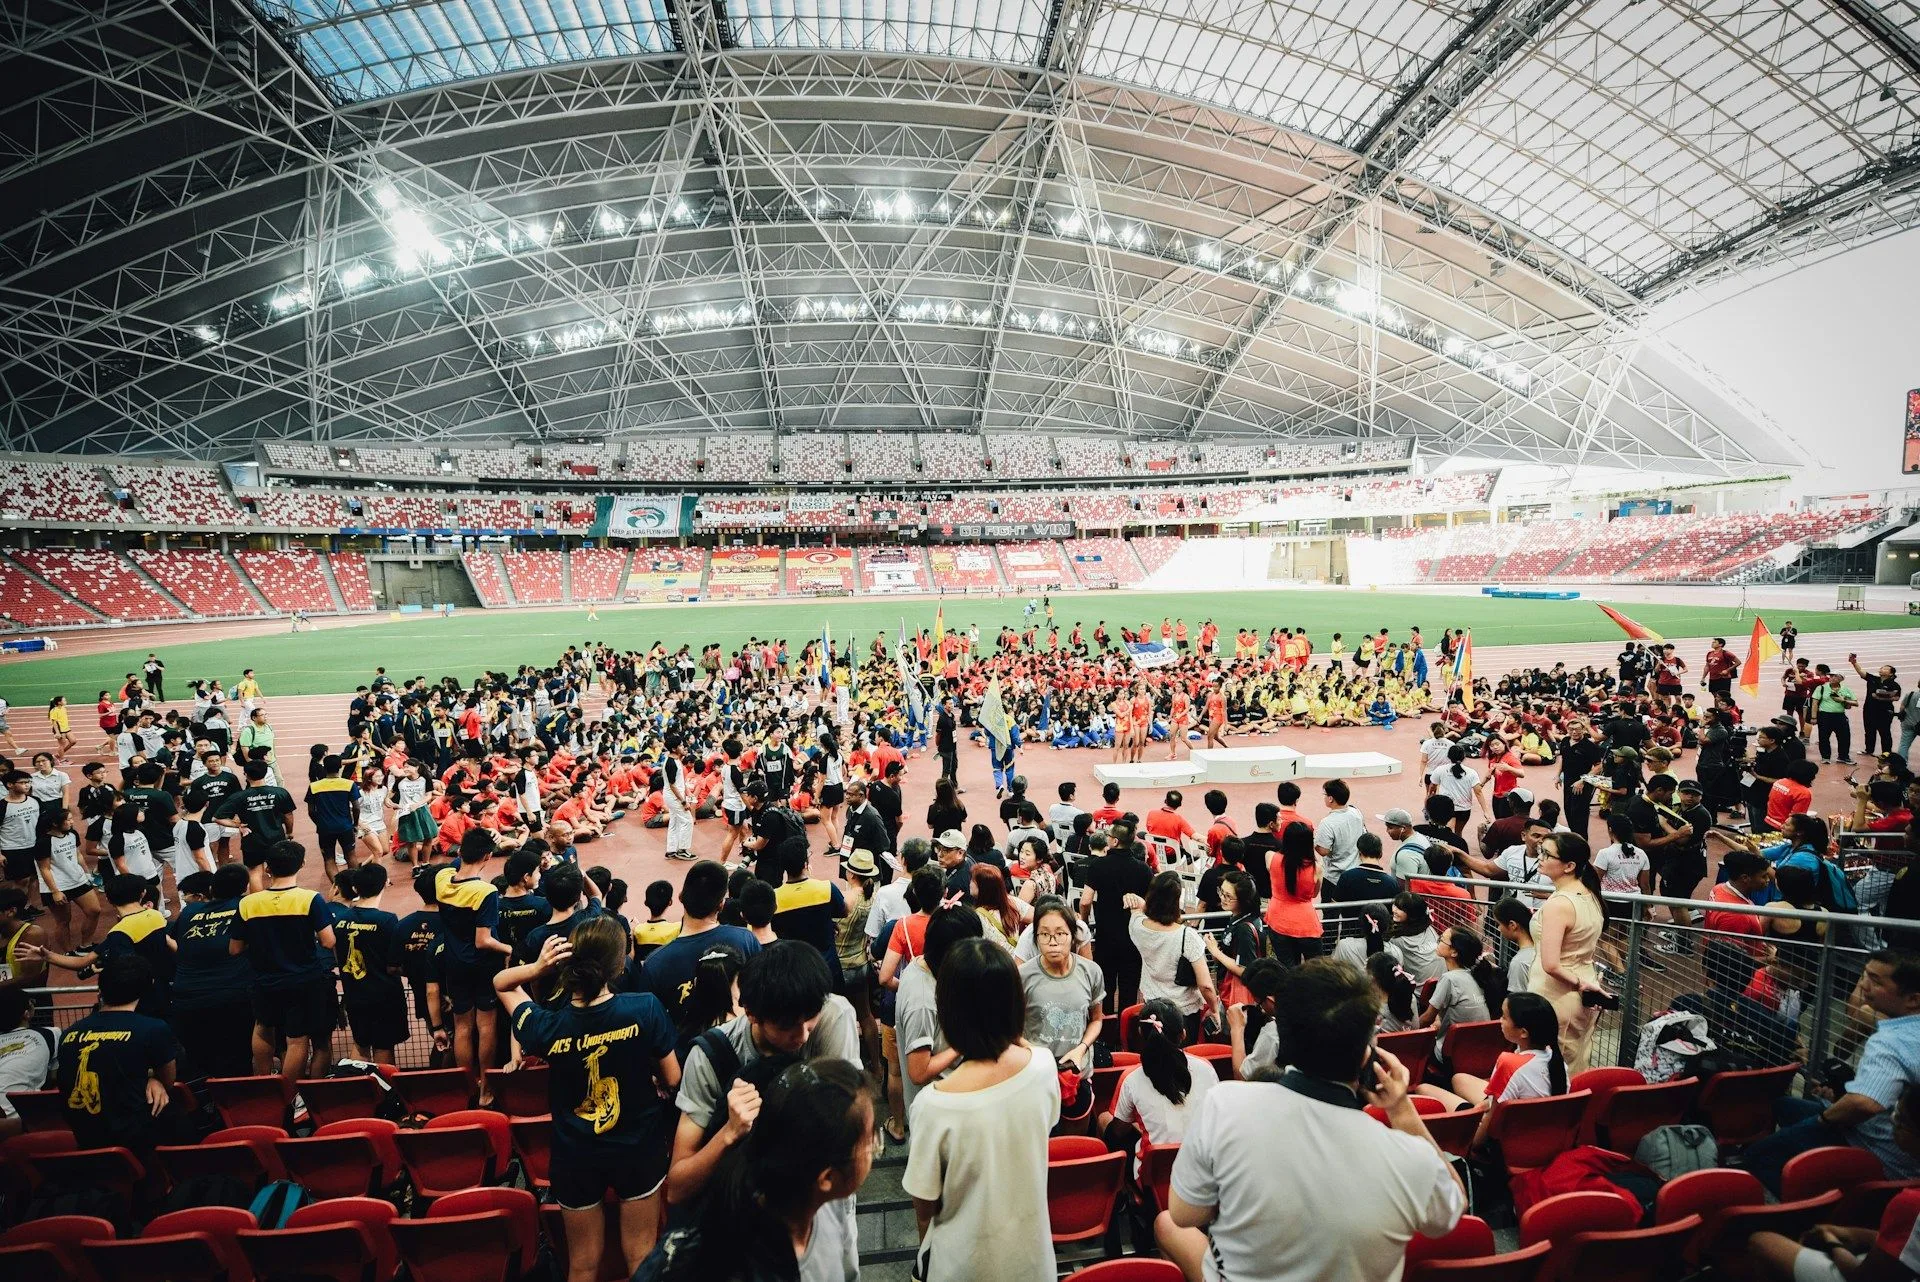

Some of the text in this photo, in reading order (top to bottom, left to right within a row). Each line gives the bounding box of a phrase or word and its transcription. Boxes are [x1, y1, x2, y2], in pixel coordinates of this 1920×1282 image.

[960, 525, 981, 536] GO
[984, 525, 1028, 536] FIGHT
[1032, 523, 1070, 535] WIN
[1291, 760, 1297, 775] 1
[1387, 765, 1393, 773] 3
[1190, 775, 1196, 783] 2
[62, 1031, 78, 1046] ACS
[547, 1023, 640, 1056] ACS (INDEPENDENT)
